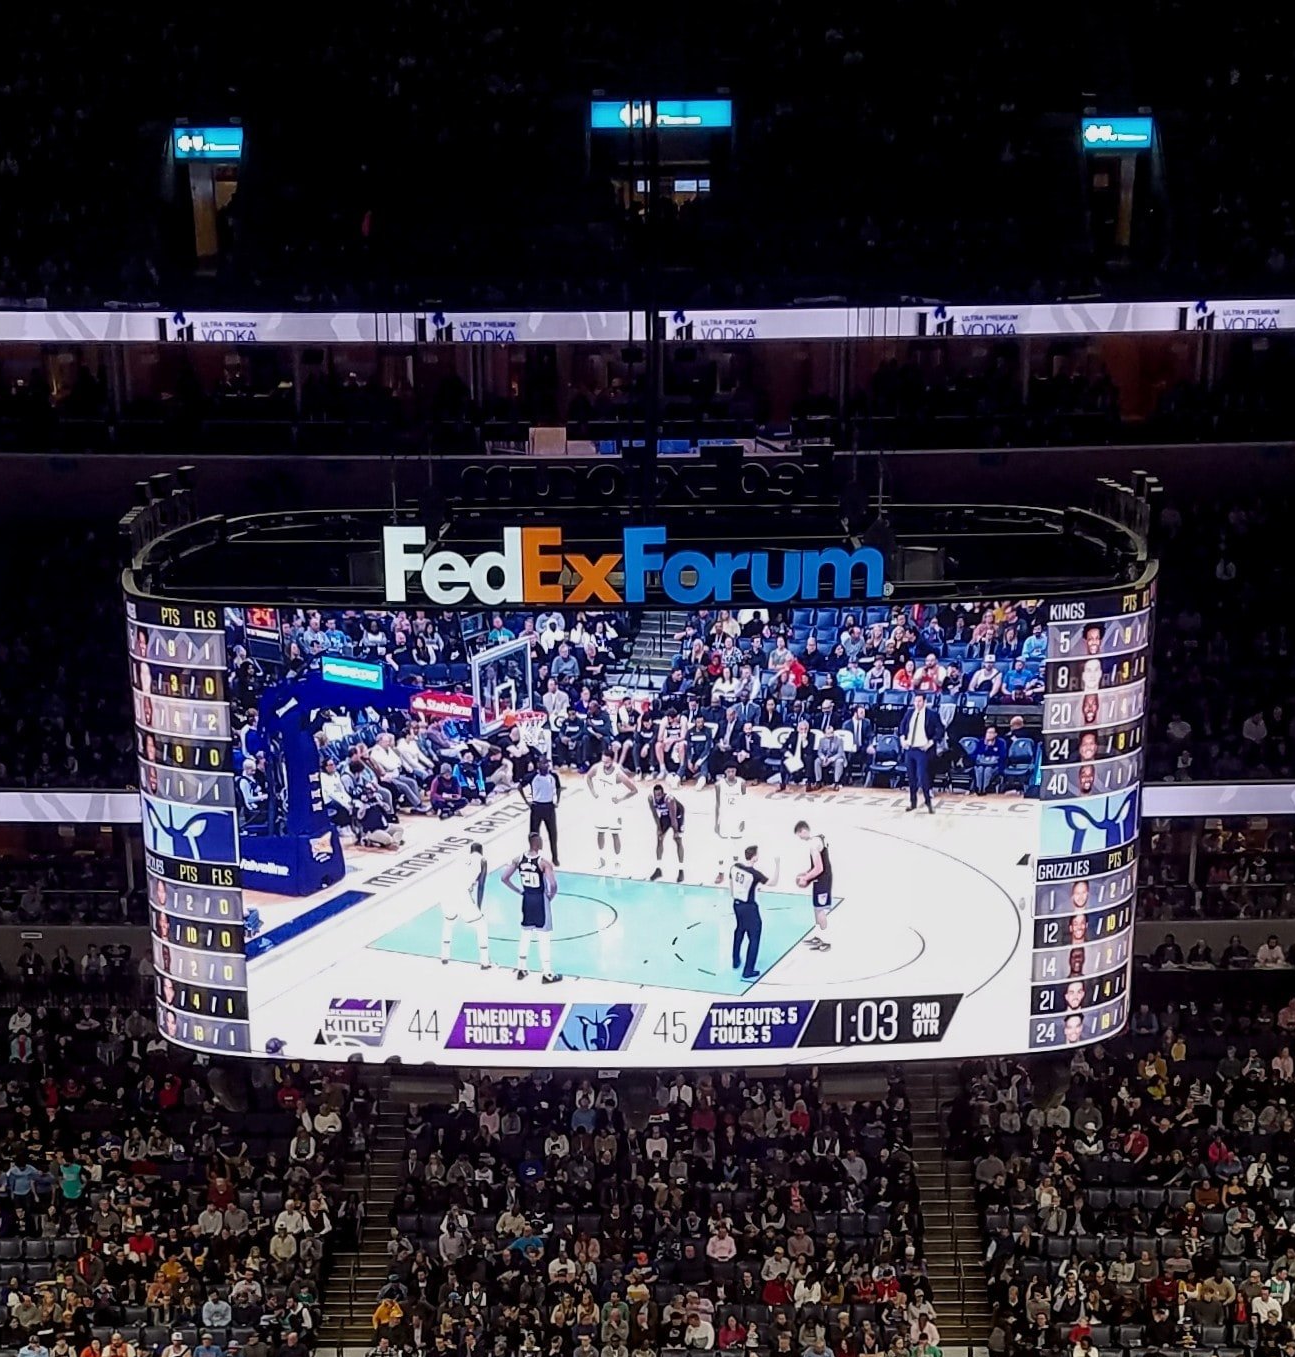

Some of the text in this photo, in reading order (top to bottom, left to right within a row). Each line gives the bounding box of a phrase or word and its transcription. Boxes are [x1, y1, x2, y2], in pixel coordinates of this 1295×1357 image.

[460, 330, 516, 342] VODKA
[961, 323, 1017, 336] VODKA
[382, 526, 885, 606] FedExForum
[160, 606, 181, 627] PTS
[194, 609, 217, 629] FLS
[1049, 602, 1086, 621] KINGS
[1059, 631, 1071, 653] 5
[1057, 666, 1069, 689] 8
[1050, 702, 1072, 726] 20
[1049, 738, 1070, 761] 24
[1046, 773, 1069, 796] 40
[179, 864, 233, 886] PTS FLS
[1037, 860, 1090, 880] GRIZZLIES
[1049, 890, 1055, 911] 1
[1043, 922, 1059, 944] 12
[1042, 957, 1057, 977] 14
[911, 1001, 941, 1021] 2ND
[1039, 990, 1055, 1011] 21
[324, 1018, 384, 1034] KINGS
[407, 1009, 440, 1041] 44
[463, 1008, 552, 1028] TIMEOUTS: 5
[709, 1006, 798, 1027] TIMEOUTS: 5
[834, 998, 899, 1044] 1:03
[463, 1027, 526, 1045] FOULS: 4
[653, 1011, 688, 1044] 45
[709, 1025, 772, 1044] FOULS: 5
[911, 1019, 939, 1038] QTR
[1036, 1022, 1056, 1043] 24
